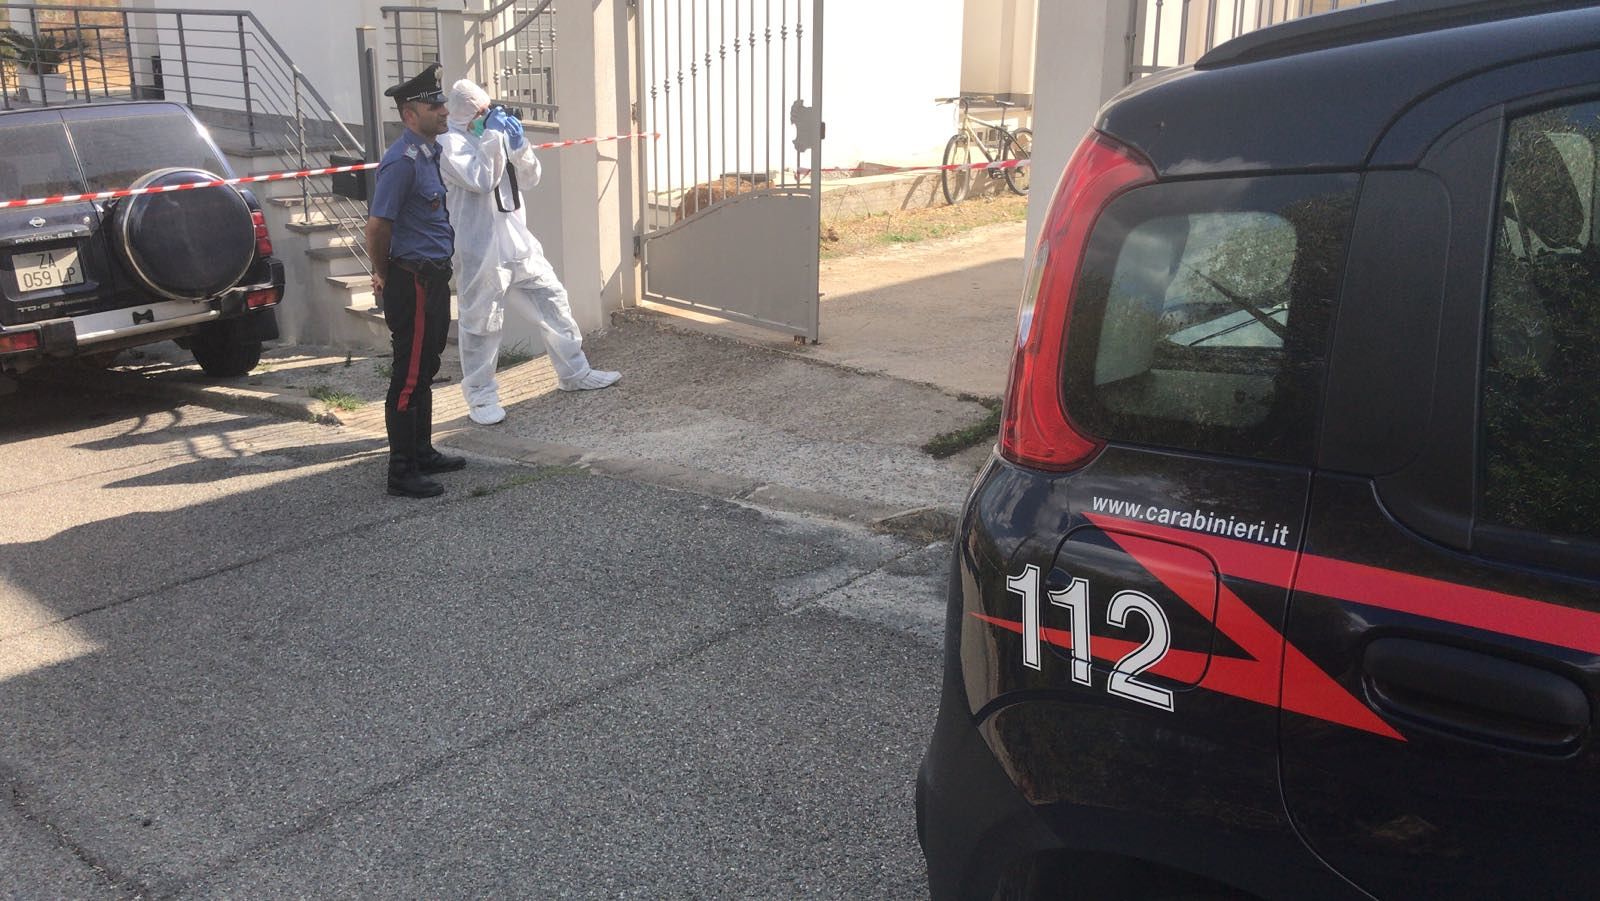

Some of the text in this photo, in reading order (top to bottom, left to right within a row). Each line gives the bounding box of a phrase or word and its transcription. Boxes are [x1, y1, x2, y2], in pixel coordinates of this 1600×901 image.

[23, 266, 76, 289] 059 LP
[37, 252, 56, 270] ZA
[1092, 496, 1290, 546] www.carabinieri.it
[1006, 563, 1175, 712] 112
